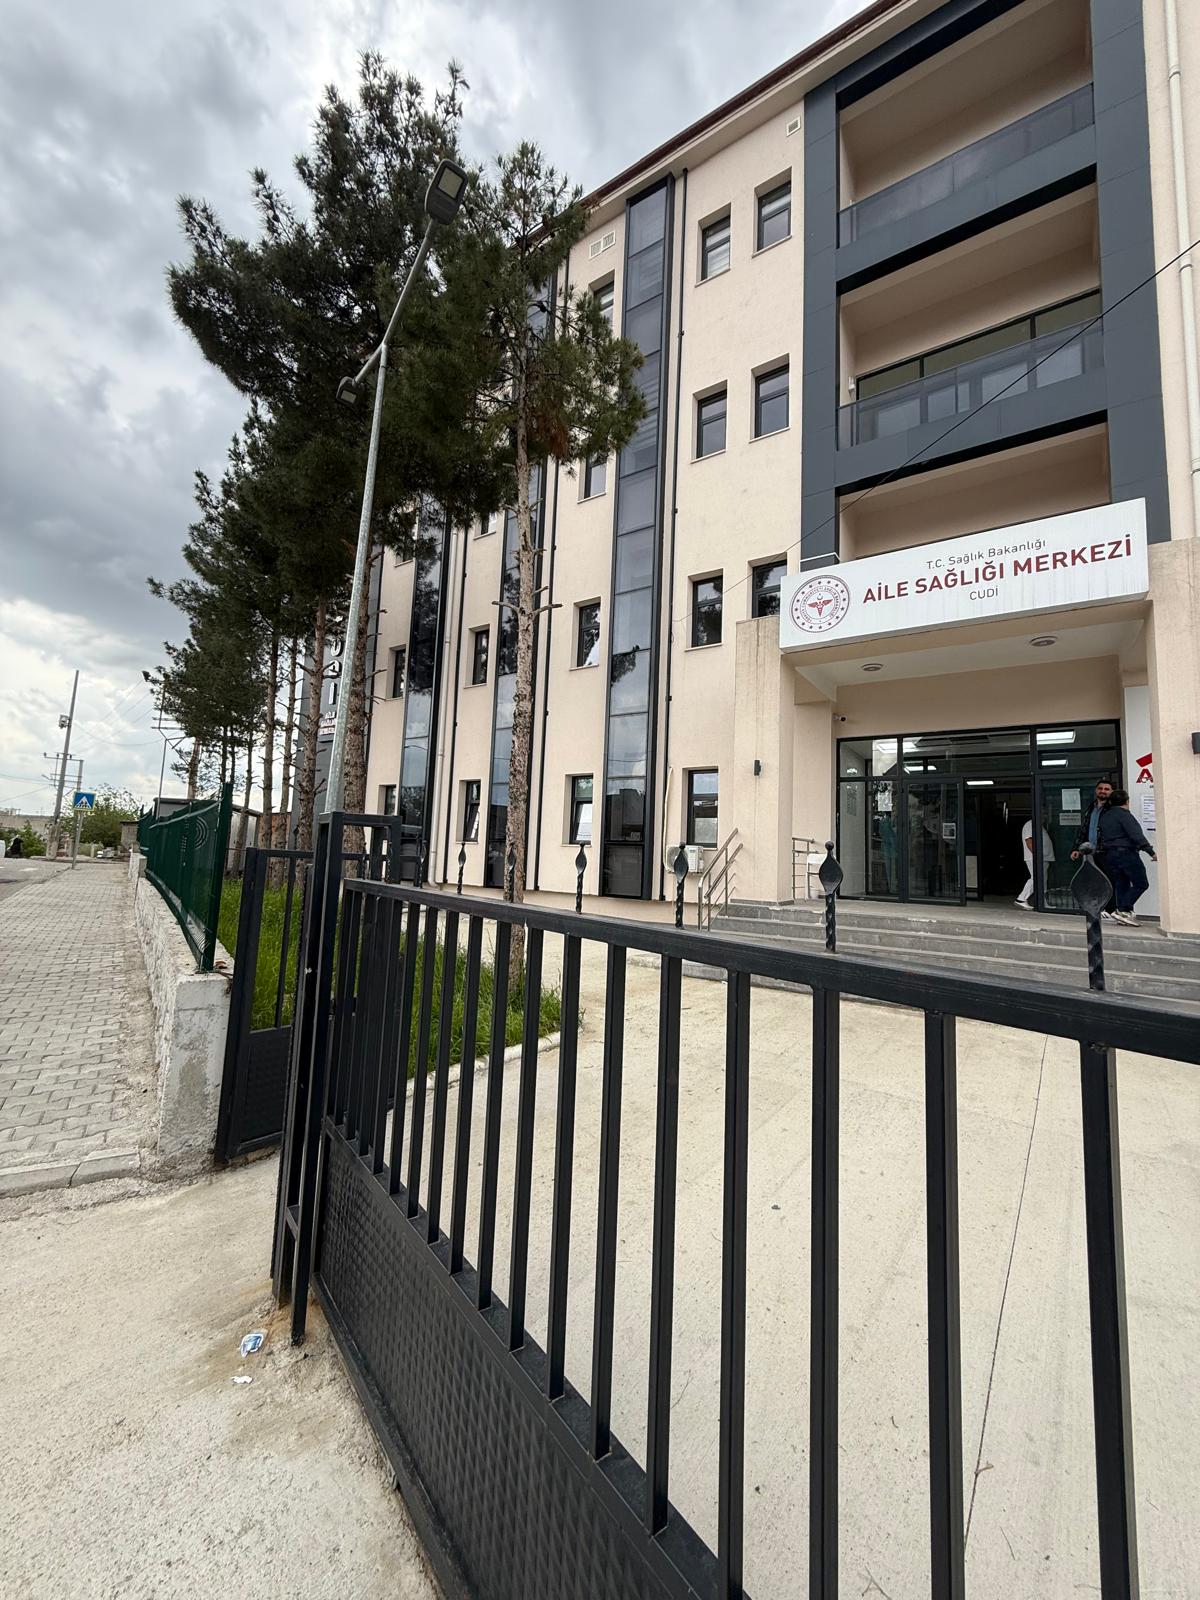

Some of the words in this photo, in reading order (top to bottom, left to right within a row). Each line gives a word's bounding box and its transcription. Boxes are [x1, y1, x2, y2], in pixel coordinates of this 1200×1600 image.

[863, 581, 909, 604] AİLE
[915, 560, 1004, 594] SAĞLIĞI
[1013, 534, 1131, 577] MERKEZİ
[926, 559, 945, 570] T.C.
[948, 551, 985, 565] Sağlık
[988, 538, 1046, 558] Bakanlığı
[969, 586, 999, 600] CUDİ
